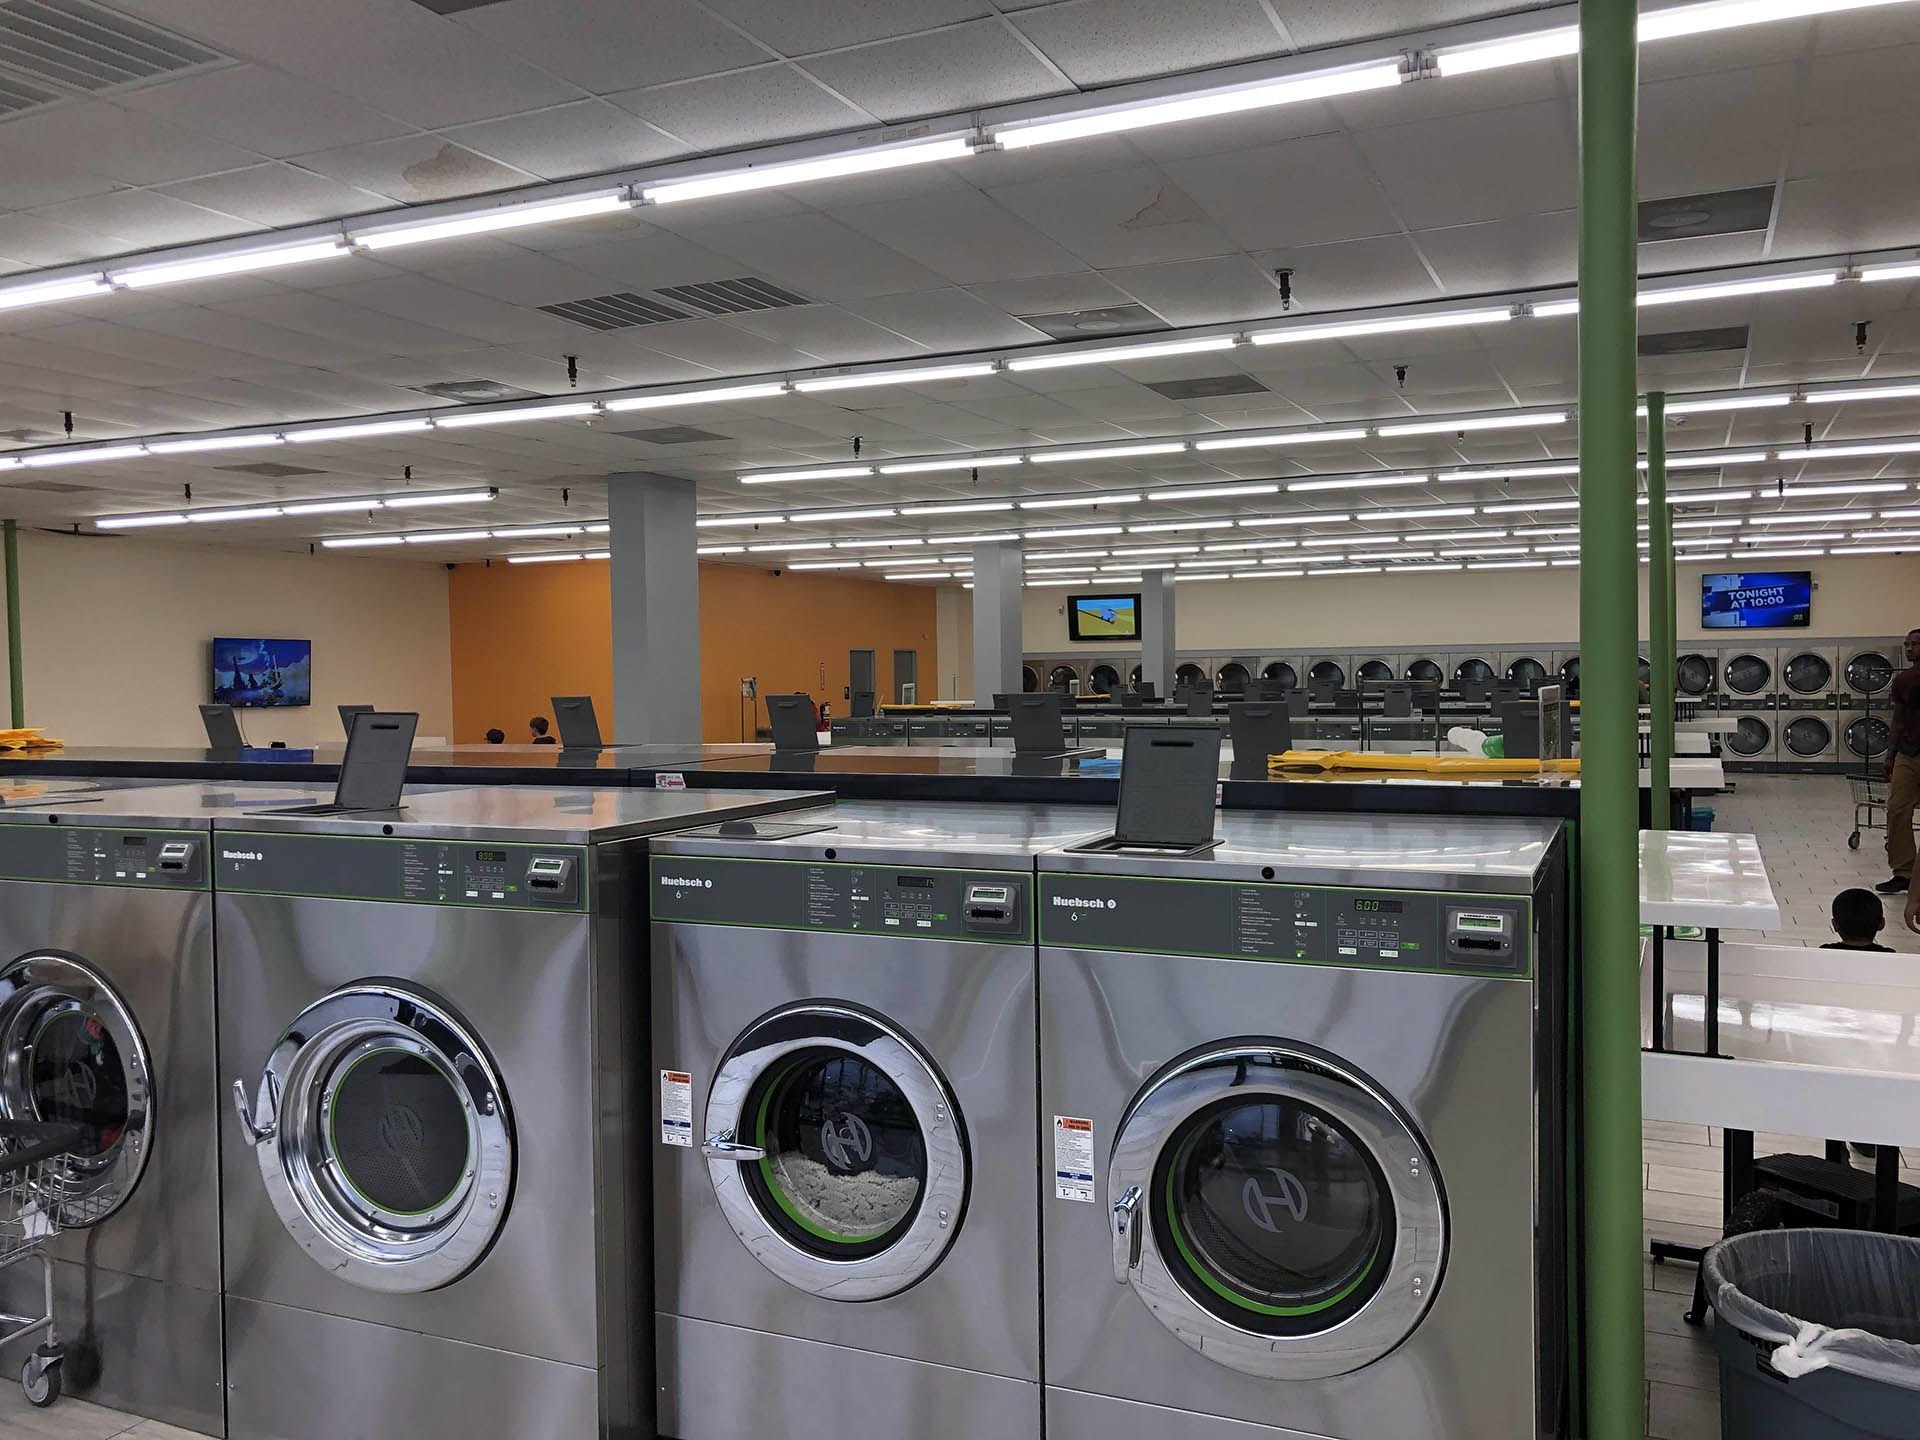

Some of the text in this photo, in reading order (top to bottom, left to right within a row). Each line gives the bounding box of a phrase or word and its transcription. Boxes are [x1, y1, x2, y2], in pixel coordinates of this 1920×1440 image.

[1728, 587, 1784, 601] TONIGHT
[1731, 596, 1784, 609] AT 10:00
[661, 876, 703, 887] Huebsch
[675, 890, 682, 899] 6
[1053, 896, 1105, 908] Huebsch
[1071, 911, 1078, 921] 6
